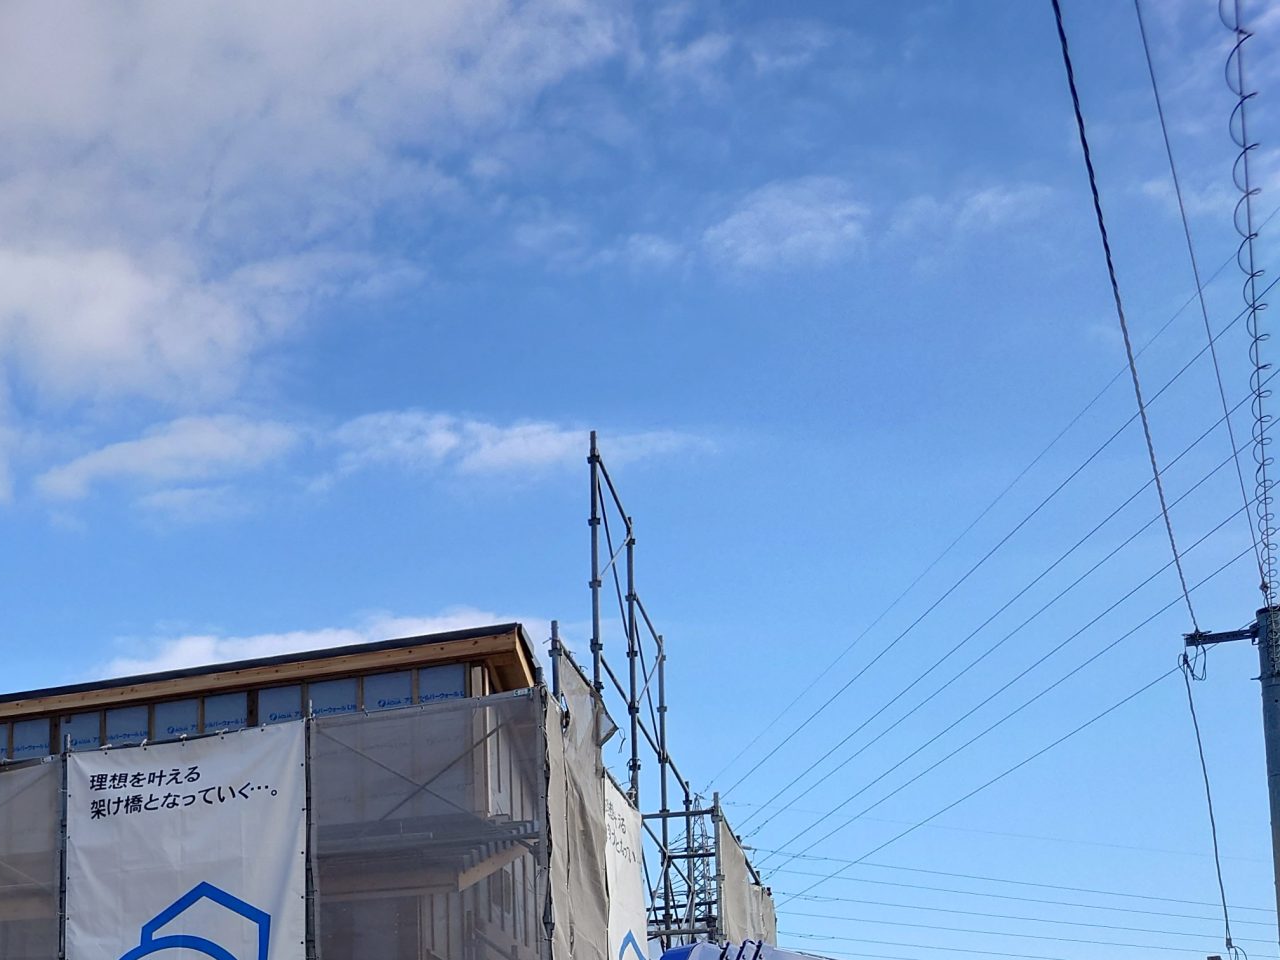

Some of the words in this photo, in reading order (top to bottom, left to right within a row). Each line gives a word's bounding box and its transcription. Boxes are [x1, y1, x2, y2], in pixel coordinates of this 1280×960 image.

[89, 765, 202, 792] 理想を叶える
